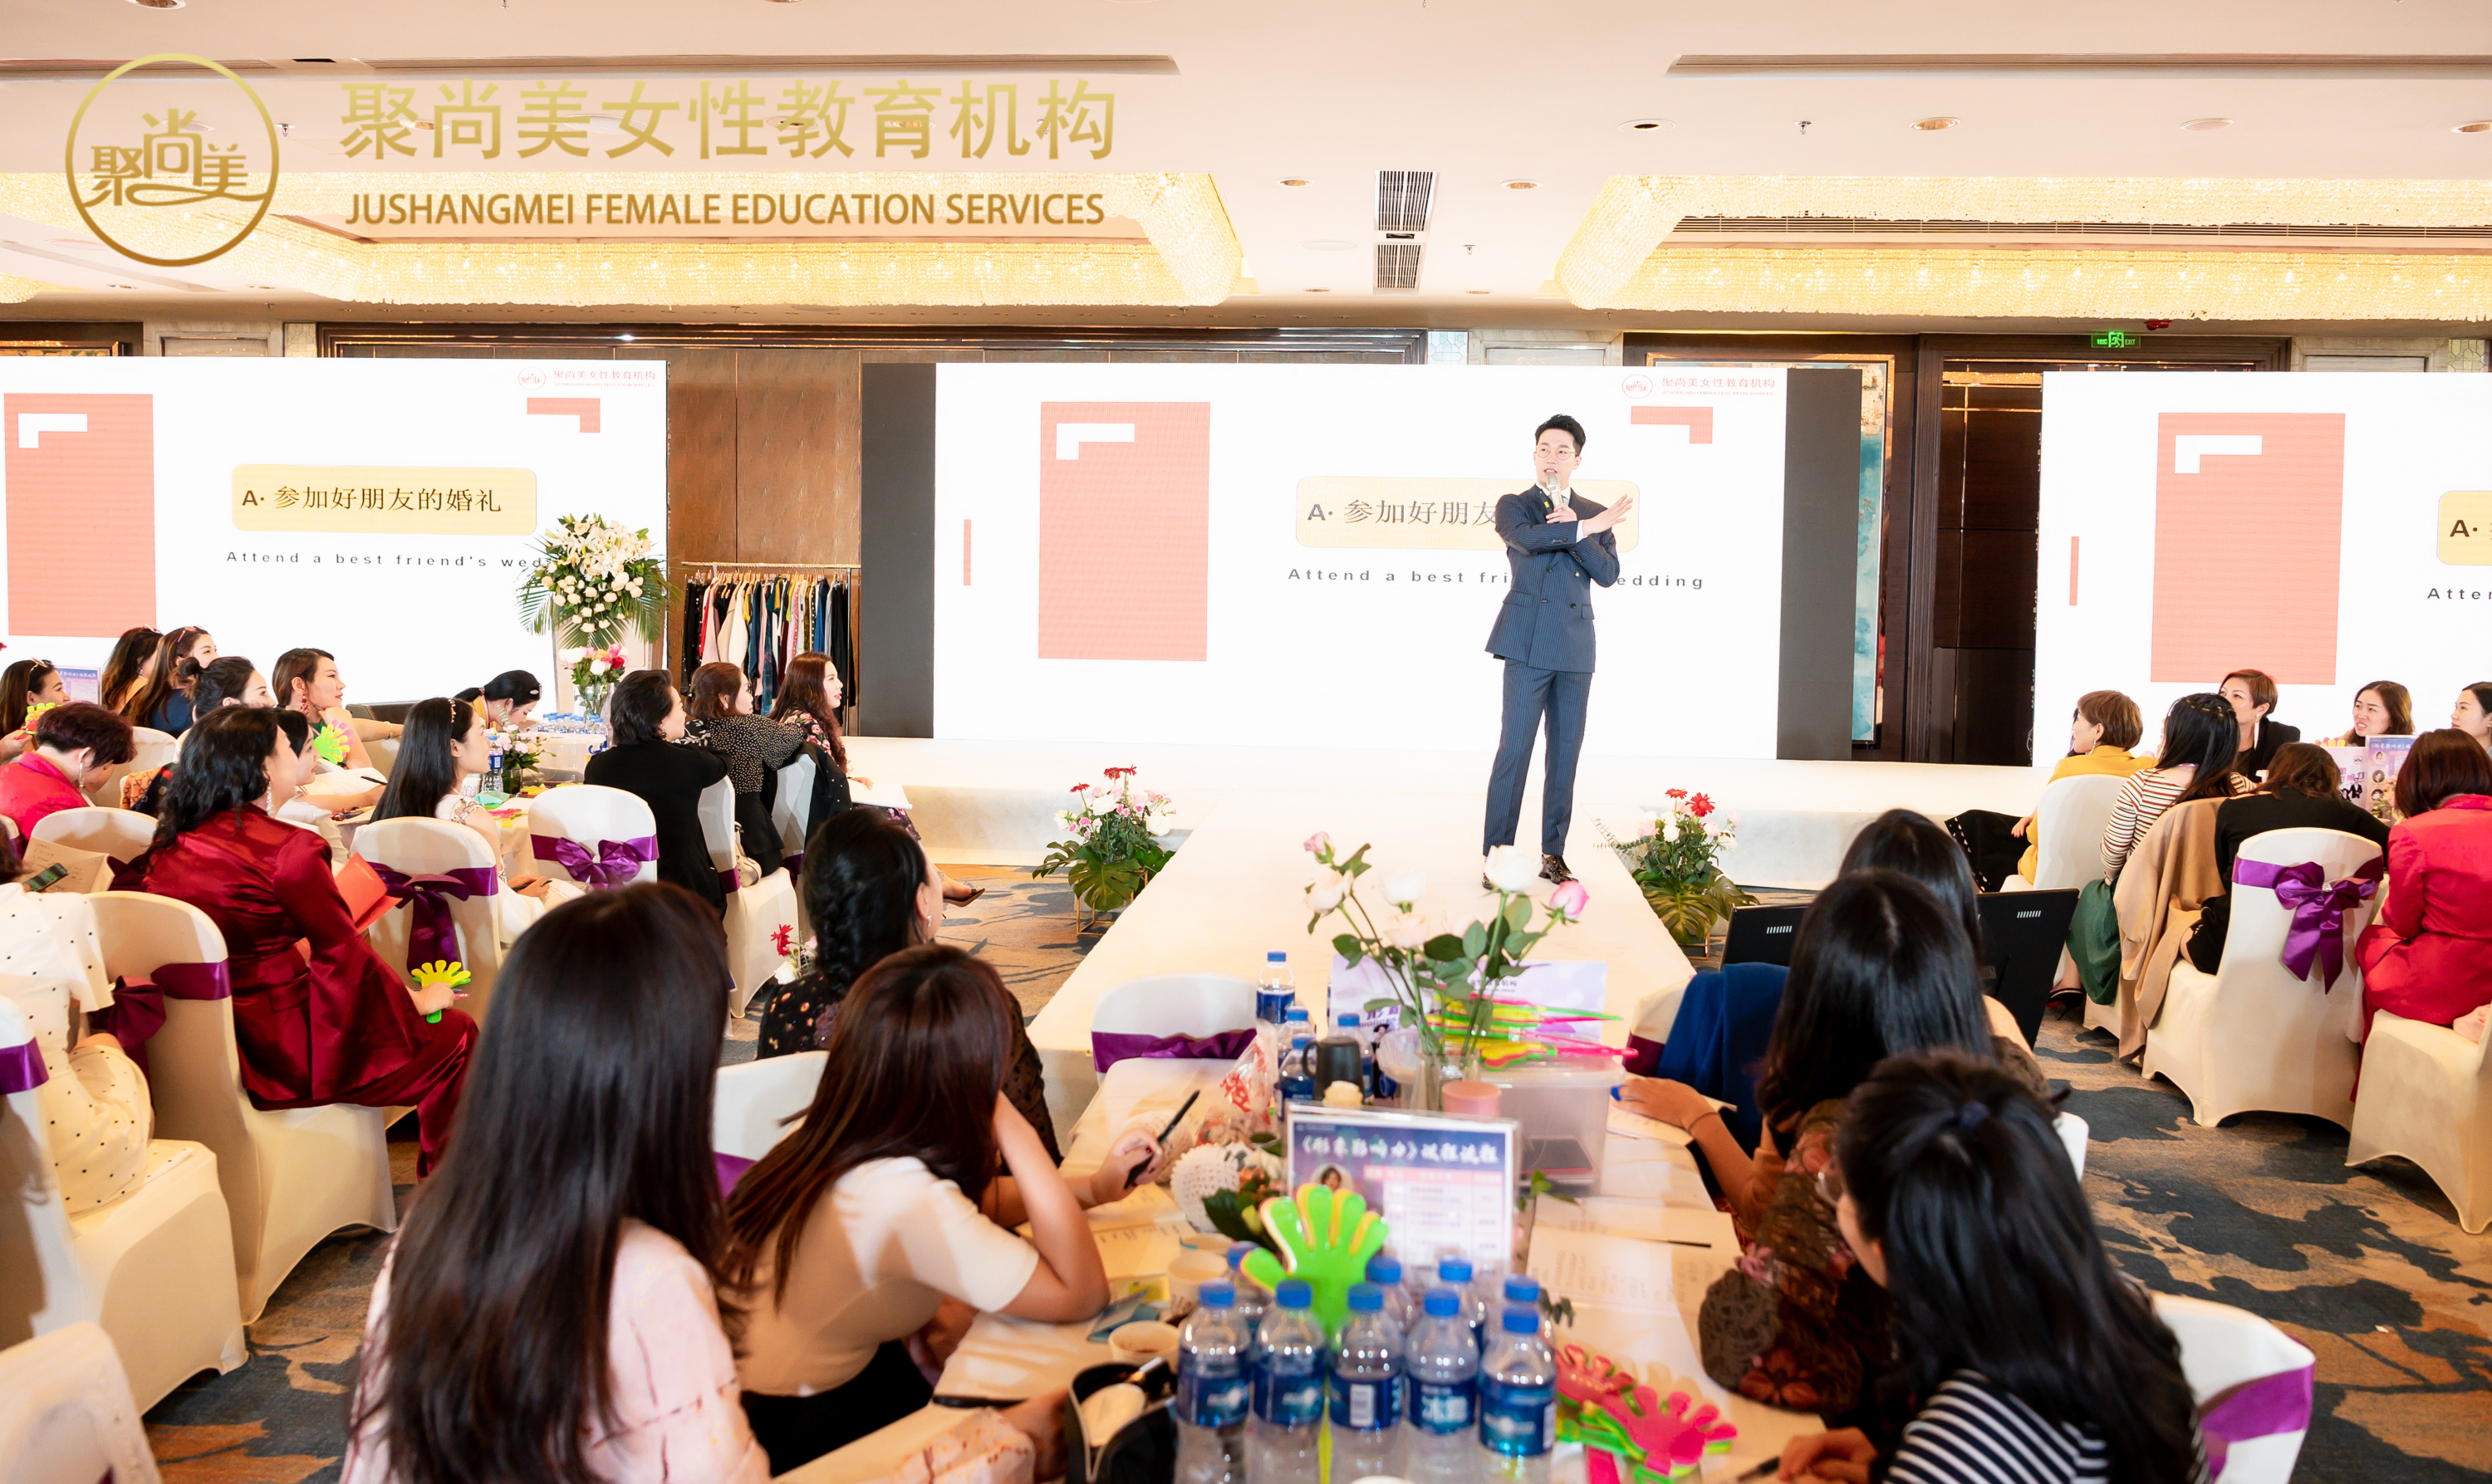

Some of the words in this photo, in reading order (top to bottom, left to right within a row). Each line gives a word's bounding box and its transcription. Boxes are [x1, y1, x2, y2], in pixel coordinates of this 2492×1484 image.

[1662, 377, 1776, 389] 聚尚美女性教育机构
[273, 485, 503, 513] 参加好朋友的婚礼
[1343, 499, 1496, 526] 参加好朋友
[227, 551, 299, 564] Attend
[313, 554, 321, 564] a
[336, 553, 382, 565] best
[396, 554, 487, 567] friend's
[501, 557, 542, 568] wed
[1288, 568, 1370, 581] Attend
[1386, 572, 1395, 581] a
[1411, 571, 1464, 582] best
[1616, 575, 1702, 590] edding
